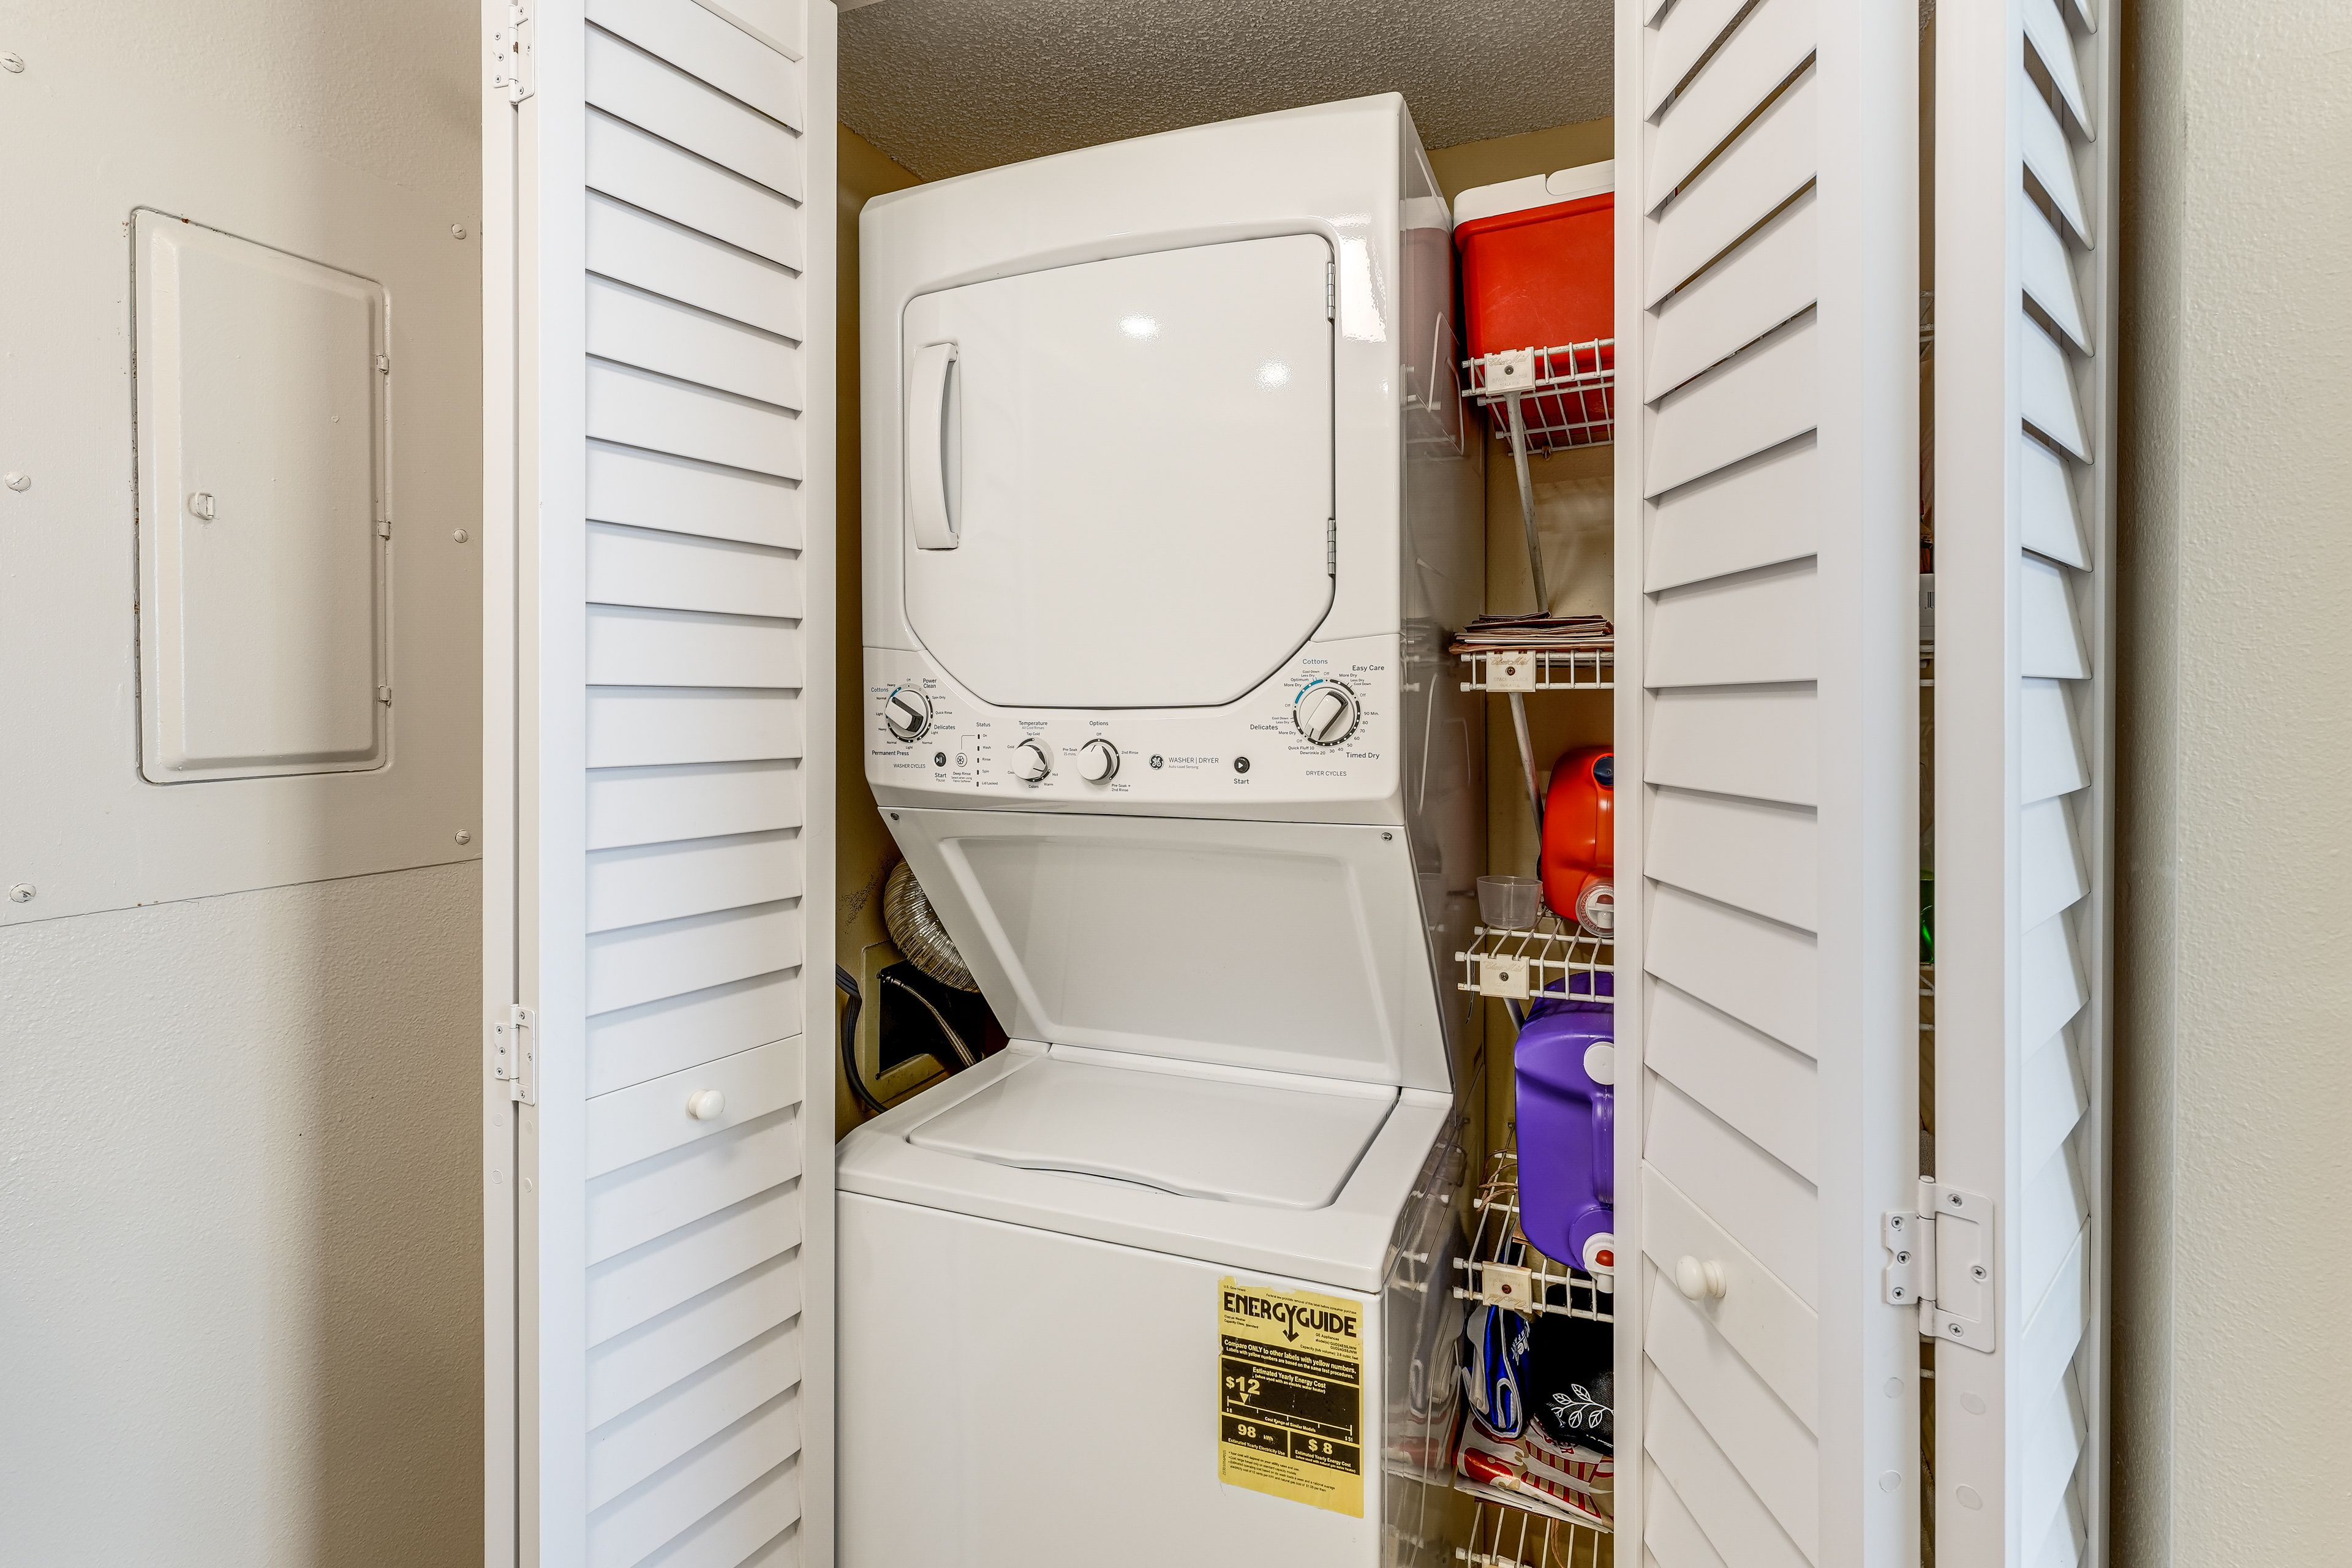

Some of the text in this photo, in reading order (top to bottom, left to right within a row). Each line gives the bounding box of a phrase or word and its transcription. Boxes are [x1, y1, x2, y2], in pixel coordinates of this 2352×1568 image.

[1224, 1291, 1357, 1339] ENERGYGUIDE
[1224, 1339, 1248, 1350] Compare
[1248, 1344, 1263, 1353] ONLY
[1284, 1352, 1300, 1361] labels
[1330, 1363, 1357, 1374] numbers.
[1253, 1366, 1326, 1389] Estimated Yearly Energy Cost
[1330, 1370, 1355, 1379] procedures.
[1225, 1376, 1261, 1395] $12
[1237, 1423, 1256, 1438] 98
[1227, 1438, 1246, 1446] Estimated
[1246, 1441, 1259, 1450] Yearly
[1259, 1445, 1278, 1455] Electricity
[1295, 1449, 1314, 1458] Estimated
[1308, 1438, 1333, 1455] $ 8
